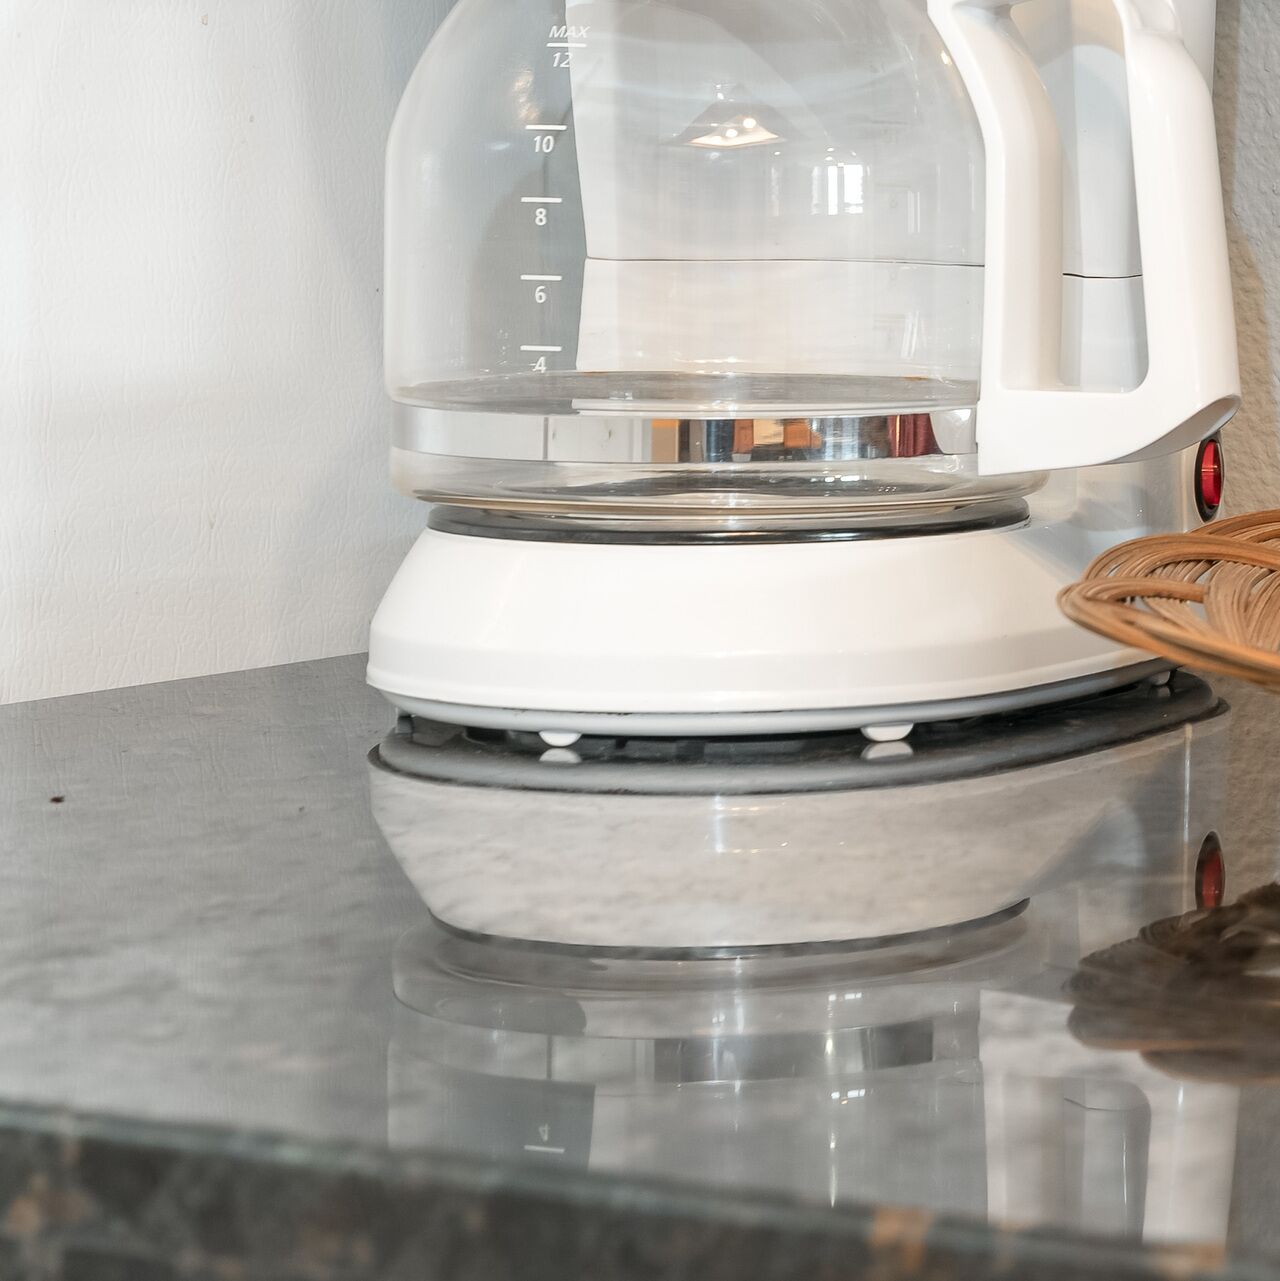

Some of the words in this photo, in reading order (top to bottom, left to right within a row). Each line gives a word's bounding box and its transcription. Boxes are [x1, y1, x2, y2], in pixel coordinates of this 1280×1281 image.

[549, 25, 591, 39] MAX
[553, 52, 574, 68] 12
[533, 135, 554, 154] 10
[535, 208, 547, 226] 8
[535, 286, 547, 303] 6
[534, 356, 547, 374] 4
